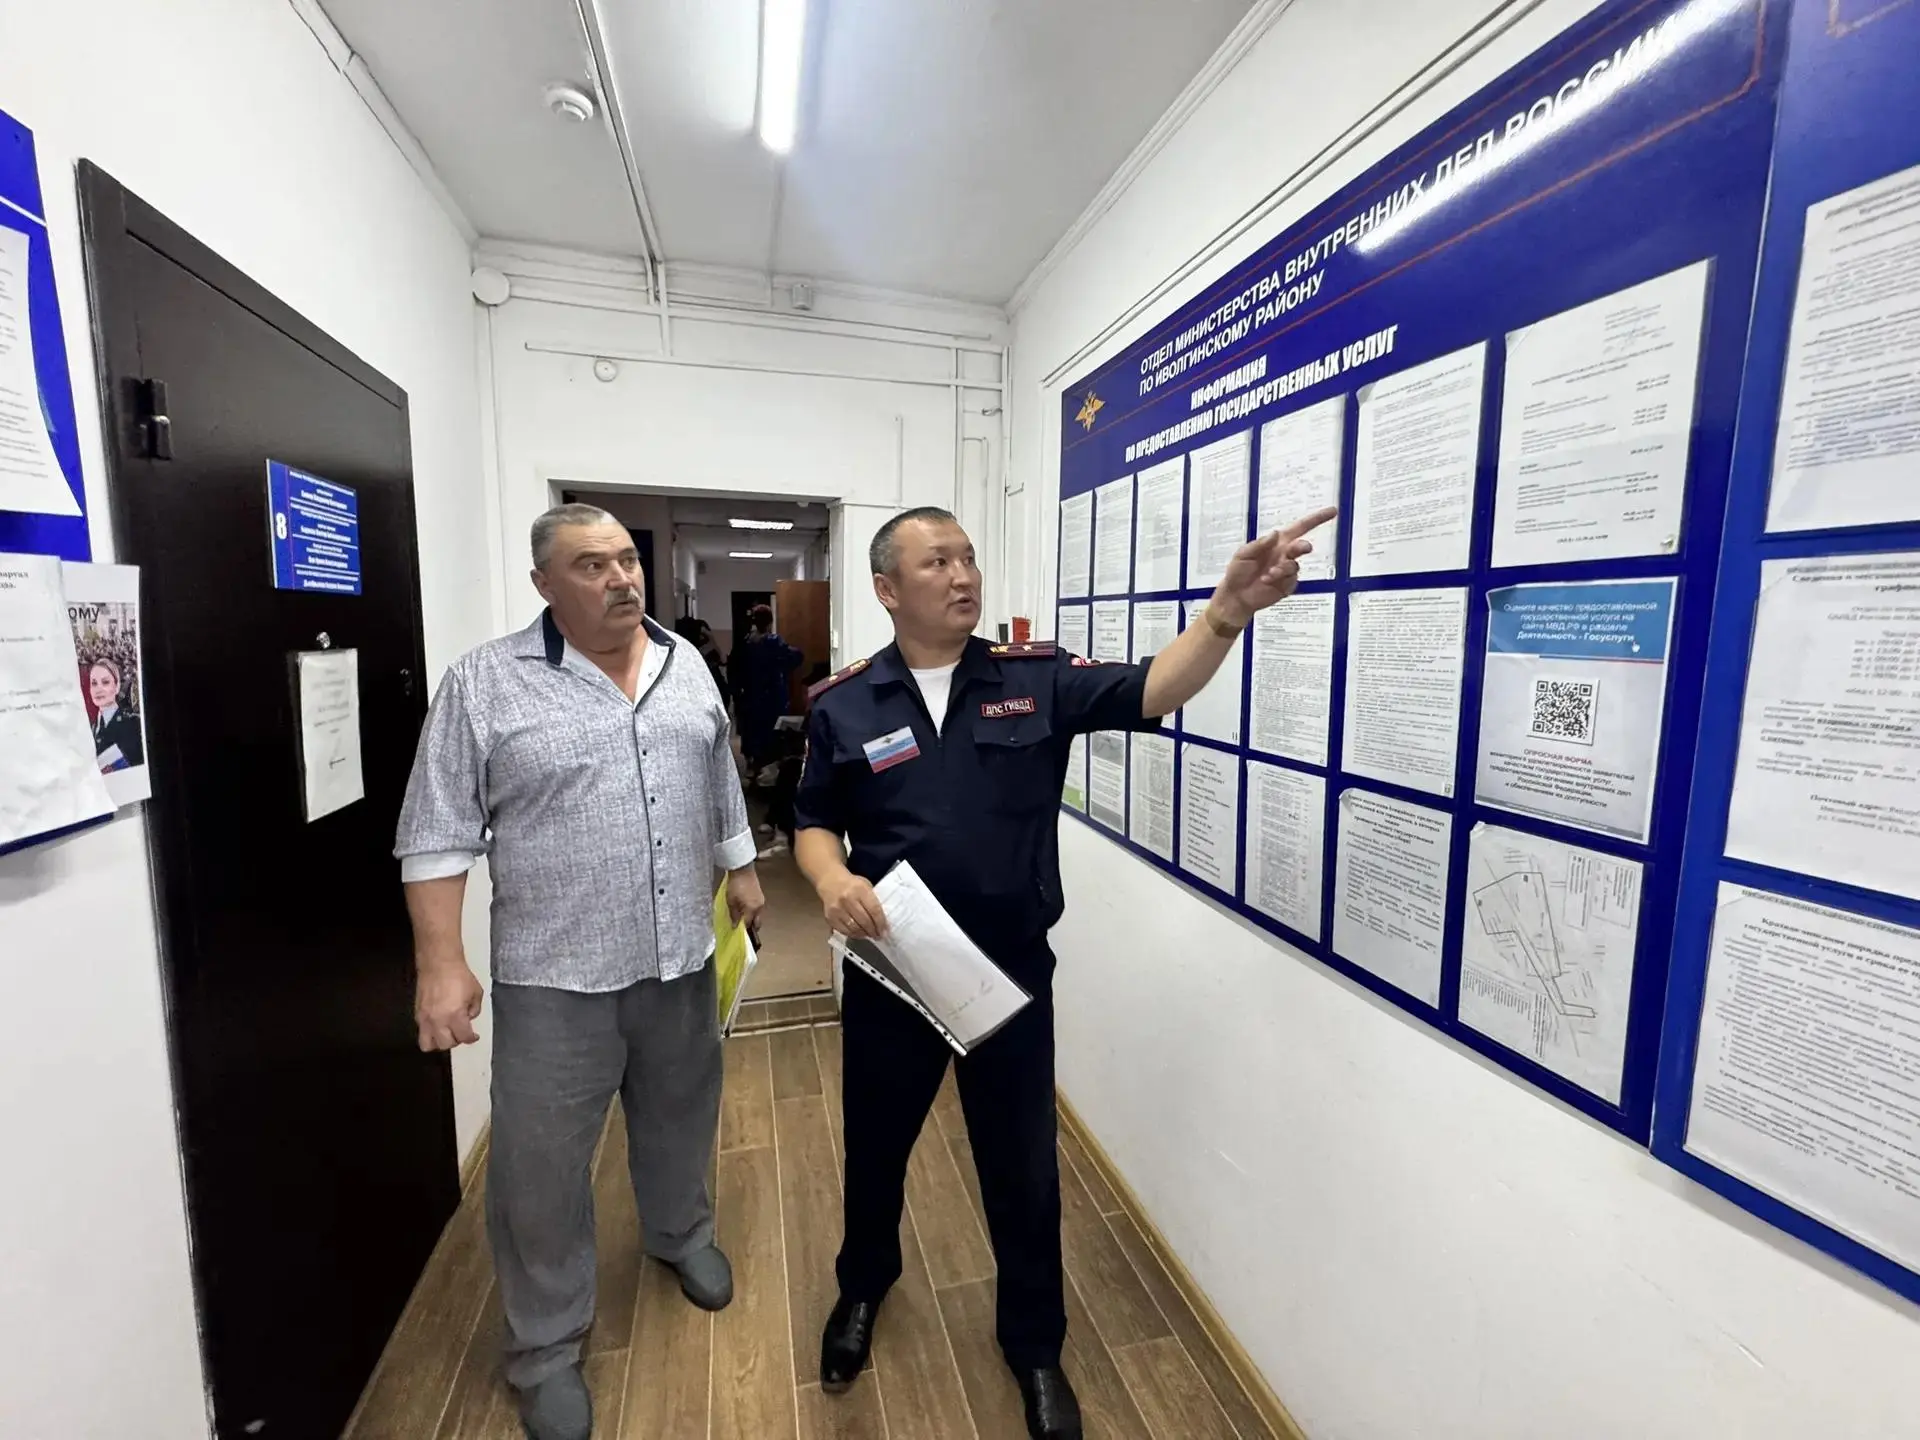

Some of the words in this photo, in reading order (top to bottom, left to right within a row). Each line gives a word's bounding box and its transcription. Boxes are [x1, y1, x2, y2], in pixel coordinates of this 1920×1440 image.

[1141, 340, 1173, 375] ОТДЕЛ
[1175, 270, 1280, 354] МИНИСТЕРСТВА
[1284, 171, 1427, 284] ВНУТРЕННИХ
[1140, 375, 1154, 396] ПО
[1155, 313, 1252, 388] ИВОЛГИНСКОМУ
[1255, 269, 1325, 329] РАЙОНУ
[1125, 444, 1135, 463] ПО
[1136, 409, 1214, 459] ПРЕДОСТАВЛЕНИЮ
[1214, 350, 1340, 426] ГОСУДАРСТВЕННЫХ
[1342, 324, 1398, 372] УСЛУГ
[1190, 354, 1267, 411] ИНФОРМАЦИЯ
[276, 512, 287, 540] 8
[1517, 631, 1577, 640] Деятельность
[1584, 632, 1635, 643] Госуслуги
[985, 704, 1004, 716] ДПС
[1004, 699, 1031, 713] ГИБДД
[1523, 748, 1563, 761] ОПРОСНАЯ
[1564, 755, 1593, 766] ФОРМА
